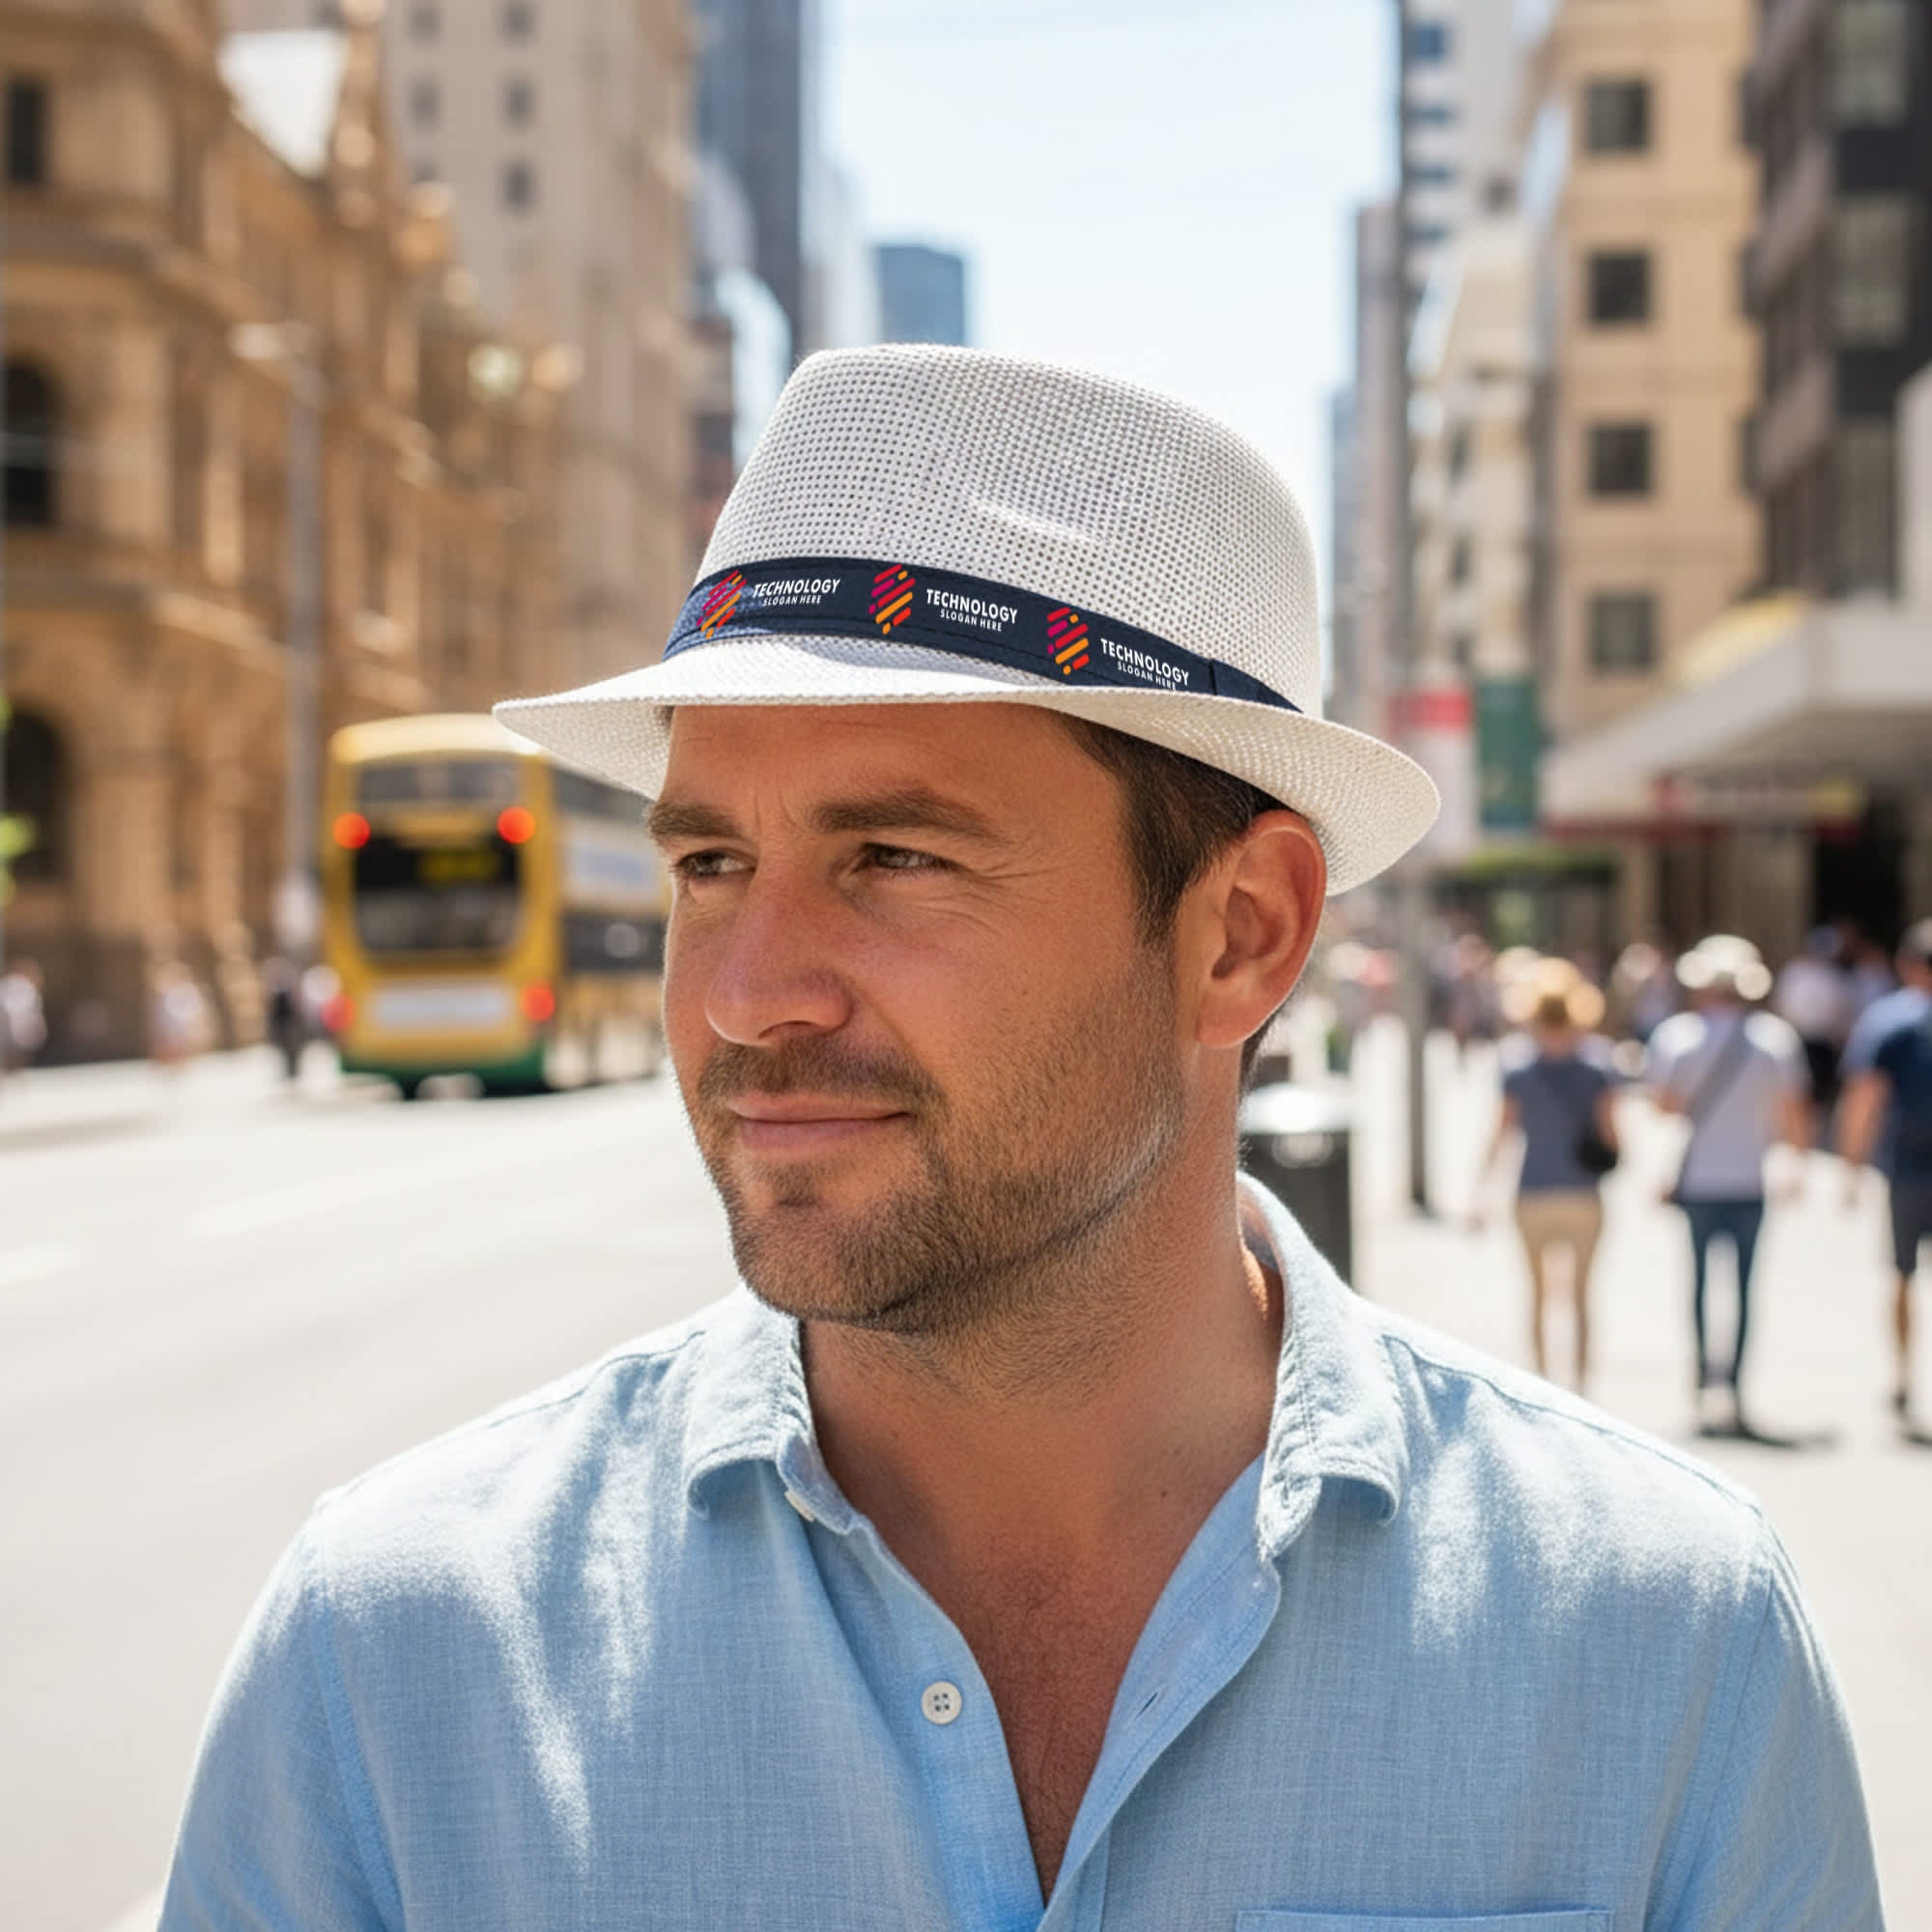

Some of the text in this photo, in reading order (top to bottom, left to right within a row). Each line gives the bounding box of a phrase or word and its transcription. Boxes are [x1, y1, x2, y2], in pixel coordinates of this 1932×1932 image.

[753, 579, 840, 598] TECHNOLOGY
[762, 594, 822, 606] SLOGAN HERE
[926, 588, 1018, 624] TECHNOLOGY
[940, 610, 1003, 632] SLOGAN HERE
[1100, 639, 1190, 686] TECHNOLOGY
[1117, 661, 1177, 691] SLOGAN HERE
